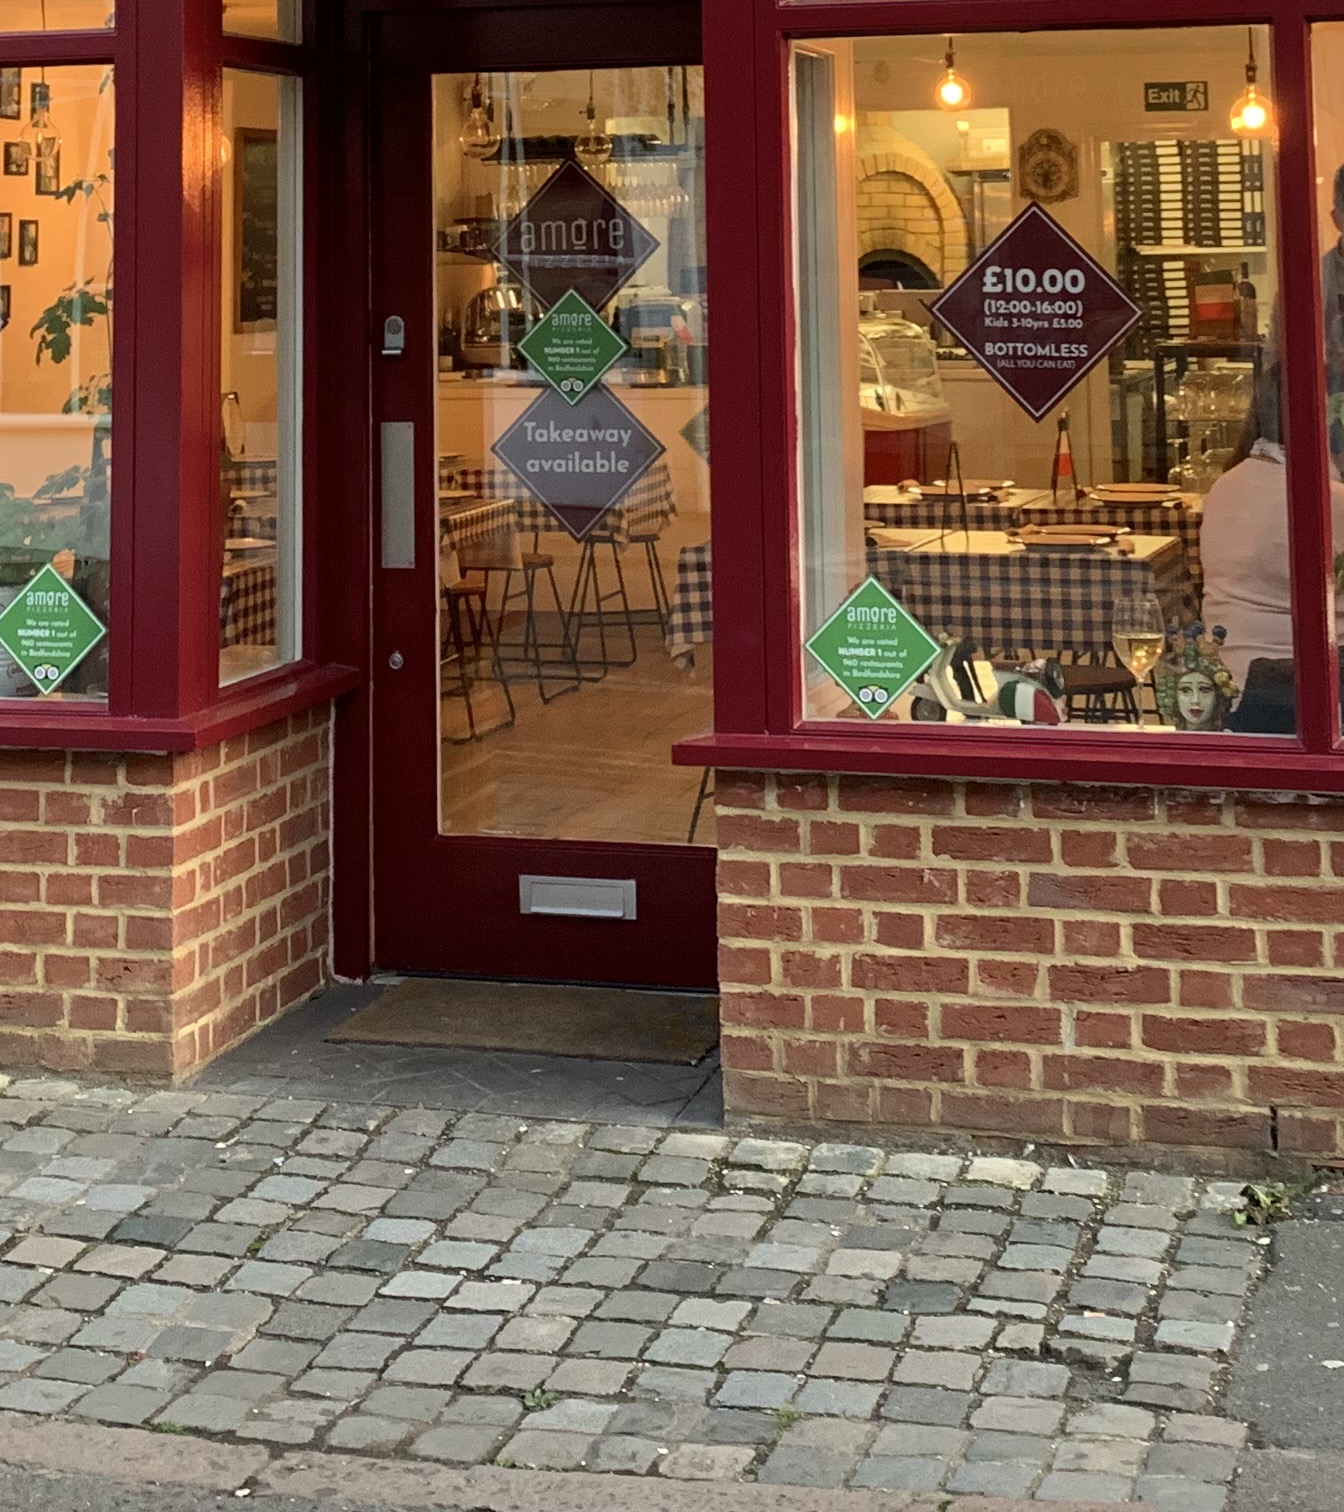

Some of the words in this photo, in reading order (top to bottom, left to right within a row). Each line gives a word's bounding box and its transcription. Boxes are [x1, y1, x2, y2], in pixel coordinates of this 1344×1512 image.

[1147, 88, 1182, 104] Exit
[520, 218, 624, 253] amore
[982, 265, 1085, 294] £10.00
[984, 299, 1083, 317] (12:00-16:00)
[551, 313, 592, 326] amore
[984, 317, 1008, 328] Kids
[1011, 318, 1049, 330] 3-10yrs
[1052, 318, 1083, 328] £5.00
[984, 342, 1088, 357] BOTTOMLESS
[997, 359, 1015, 369] (ALL
[1017, 360, 1035, 369] YOU
[1036, 360, 1056, 369] CAN
[524, 422, 632, 447] Takeaway
[526, 448, 629, 473] available
[26, 591, 69, 606] amore
[847, 606, 897, 623] amore
[17, 628, 50, 637] NUMBER
[838, 647, 876, 656] NUMBER
